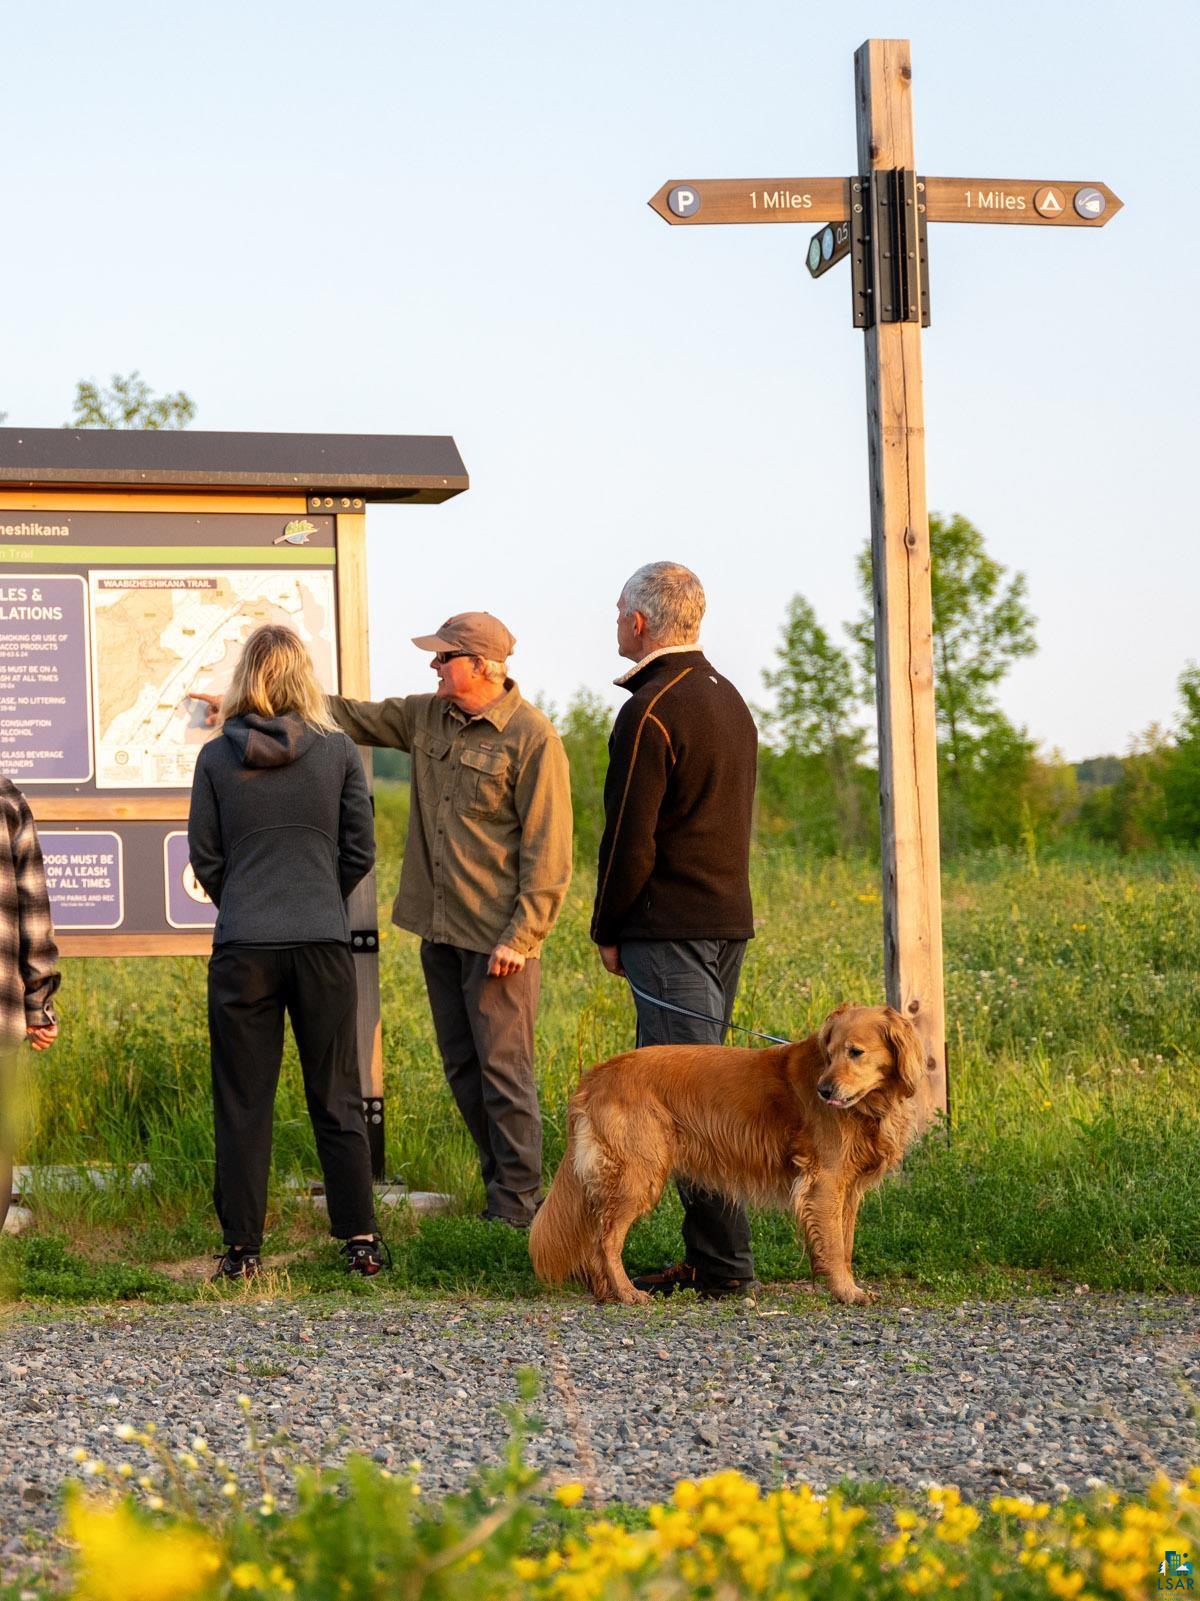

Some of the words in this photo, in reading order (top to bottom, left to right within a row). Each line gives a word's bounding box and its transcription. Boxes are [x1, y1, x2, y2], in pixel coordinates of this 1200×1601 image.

[677, 191, 694, 212] P
[749, 192, 757, 208] 1
[763, 191, 813, 208] Miles
[964, 191, 972, 208] 1
[978, 191, 1026, 210] Miles
[11, 549, 33, 559] Trail
[103, 580, 186, 588] WAABIZHESHIKANA
[187, 580, 212, 588] TRAIL
[31, 588, 42, 601] &
[31, 634, 42, 642] OR
[42, 634, 57, 642] USE
[57, 634, 68, 642] OF
[20, 643, 58, 651] PRODUCTS
[7, 665, 28, 673] MUST
[28, 665, 38, 673] BE
[39, 665, 51, 673] ON
[51, 665, 58, 673] A
[11, 674, 21, 682] AT
[22, 674, 36, 682] ALL
[37, 674, 59, 682] TIMES
[0, 719, 52, 727] CONSUMPTION
[0, 728, 33, 736] ALCOHOL
[70, 855, 98, 865] MUST
[100, 855, 114, 865] BE
[47, 866, 62, 876] ON
[65, 866, 73, 876] A
[75, 866, 108, 876] LEASH
[60, 878, 79, 888] ALL
[81, 878, 111, 888] TIMES
